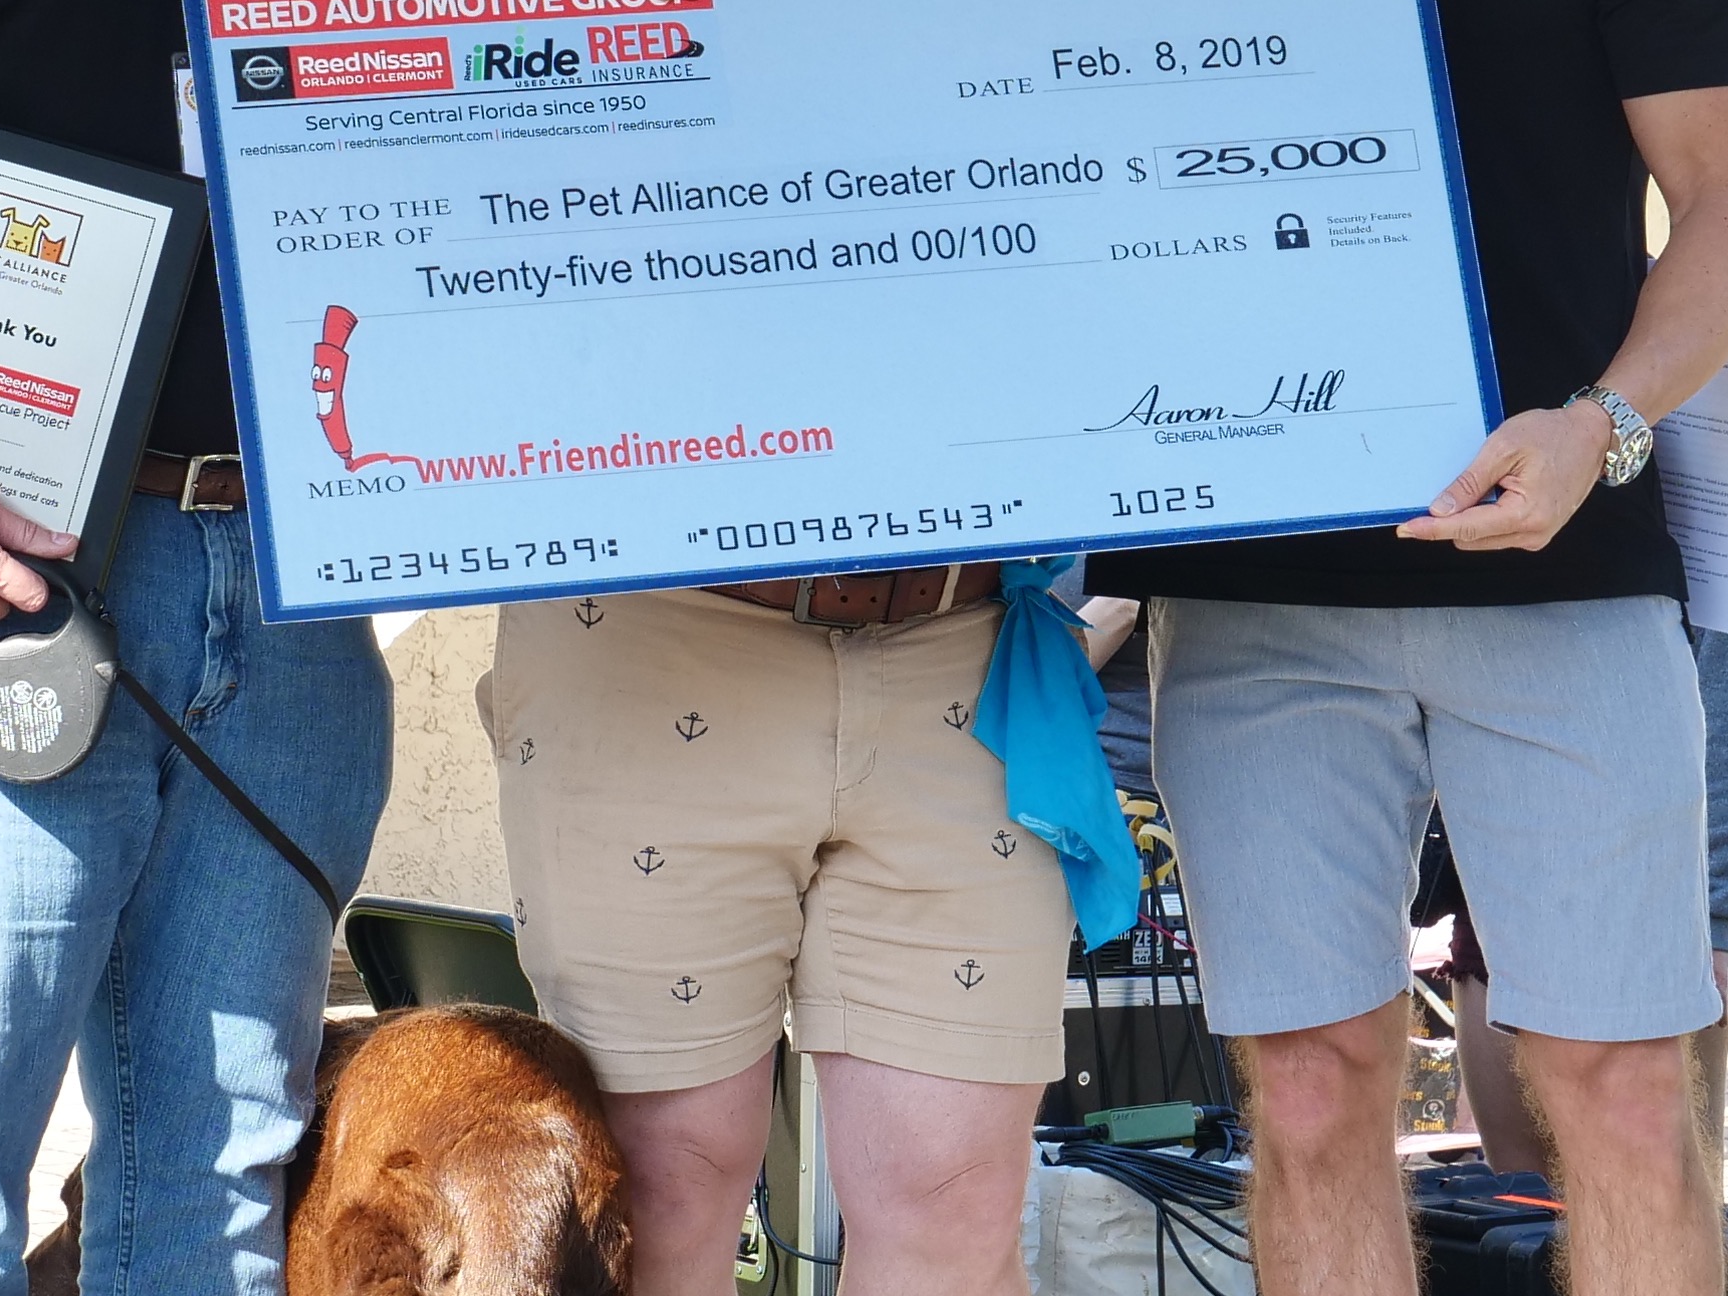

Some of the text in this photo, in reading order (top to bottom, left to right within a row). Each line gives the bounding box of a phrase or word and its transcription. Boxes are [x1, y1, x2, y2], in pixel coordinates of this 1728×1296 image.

[222, 0, 318, 31] REED
[586, 20, 692, 64] REED
[244, 67, 281, 77] NISSAN
[473, 34, 580, 82] iRide
[592, 63, 694, 83] INSURANCE
[957, 33, 1289, 99] DATE Feb. 8, 2019
[300, 69, 445, 89] ORLANDO CLERMONT
[515, 76, 583, 88] USED CARS
[305, 94, 647, 132] Serving Central Florida since 1950
[240, 115, 716, 157] reednissan.com reednissanclermont.com irideusedcars.com reedinsures.com
[480, 135, 1388, 226] The Pet Alliance of Greater Orlando $ 25,000
[272, 197, 454, 228] PAY TO THE
[1326, 210, 1413, 225] Security Features
[275, 225, 435, 255] ORDER OF
[1330, 236, 1366, 248] Details
[1368, 237, 1381, 245] on
[3, 258, 68, 284] ALLIANCE
[415, 222, 1248, 300] Twenty-five thousand and 00/100 DOLLARS
[23, 324, 58, 348] You
[1083, 369, 1345, 432] Aaron Hill
[23, 407, 71, 432] Project
[1154, 422, 1285, 445] GENERAL MANAGER
[307, 423, 834, 500] MEMO www.Friendinreed.com
[13, 468, 63, 489] dedication
[19, 490, 40, 502] and
[41, 496, 60, 509] cats
[1112, 484, 1216, 517] 1025
